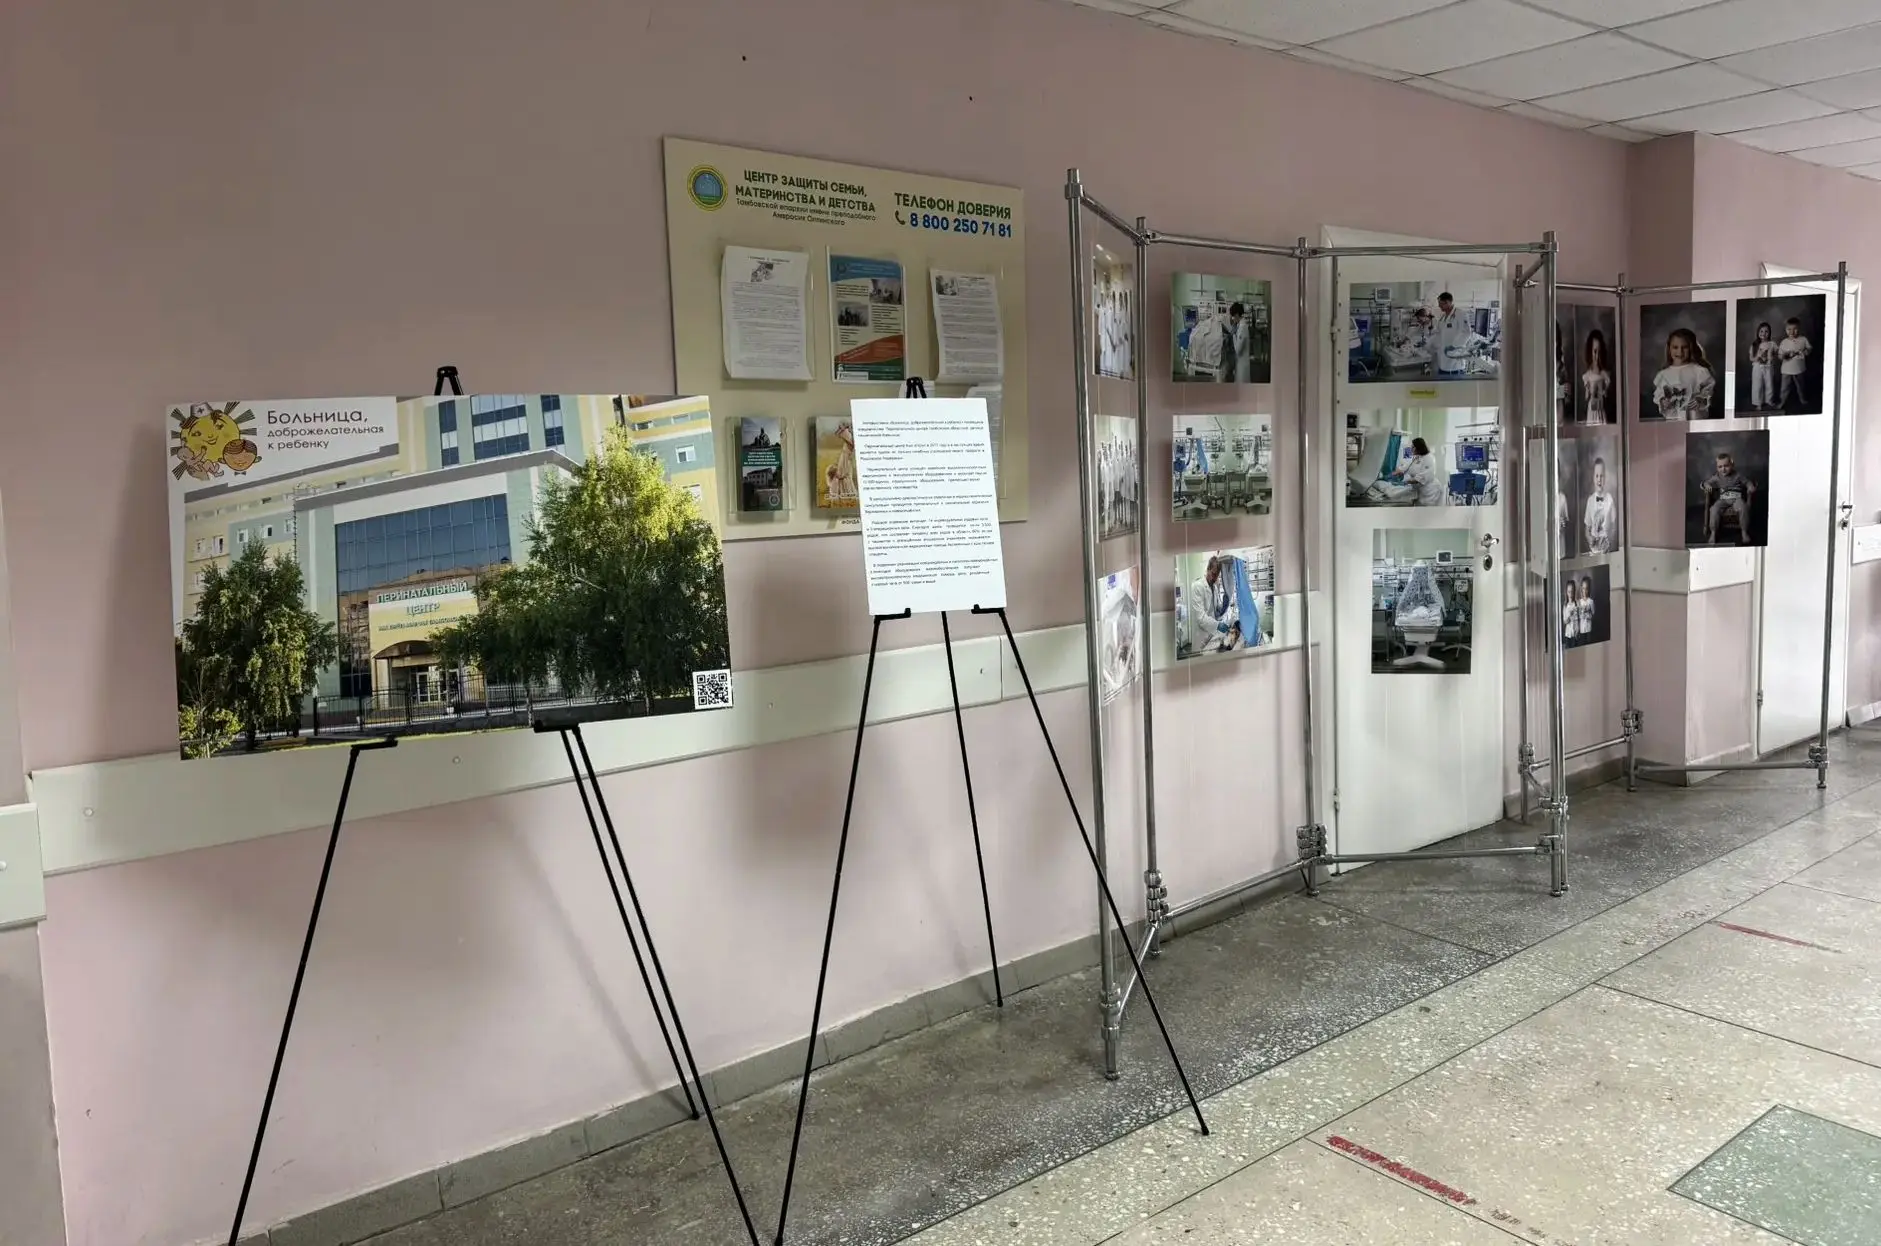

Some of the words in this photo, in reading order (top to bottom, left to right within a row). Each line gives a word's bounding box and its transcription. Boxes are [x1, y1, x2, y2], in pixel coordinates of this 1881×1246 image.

[744, 169, 778, 183] ЦЕНТР
[781, 175, 828, 191] ЗАЩИТЫ
[830, 182, 867, 197] СЕМЬИ,
[735, 185, 816, 205] МАТЕРИНСТВА
[818, 196, 826, 206] И
[828, 197, 876, 212] ДЕТСТВА
[736, 198, 778, 209] Тамбовской
[894, 192, 954, 212] ТЕЛЕФОН
[957, 201, 1011, 219] ДОВЕРИЯ
[910, 212, 918, 227] 8
[922, 214, 949, 230] 800
[953, 218, 978, 234] 250
[982, 221, 995, 236] 71
[999, 223, 1012, 238] 81
[267, 410, 369, 425] Больница,
[267, 425, 384, 438] доброжелательная
[268, 442, 274, 450] к
[278, 438, 330, 450] ребенку
[376, 581, 469, 603] ПЕРИНАТАЛЬНЫЙ
[406, 602, 441, 616] ЦЕНТР
